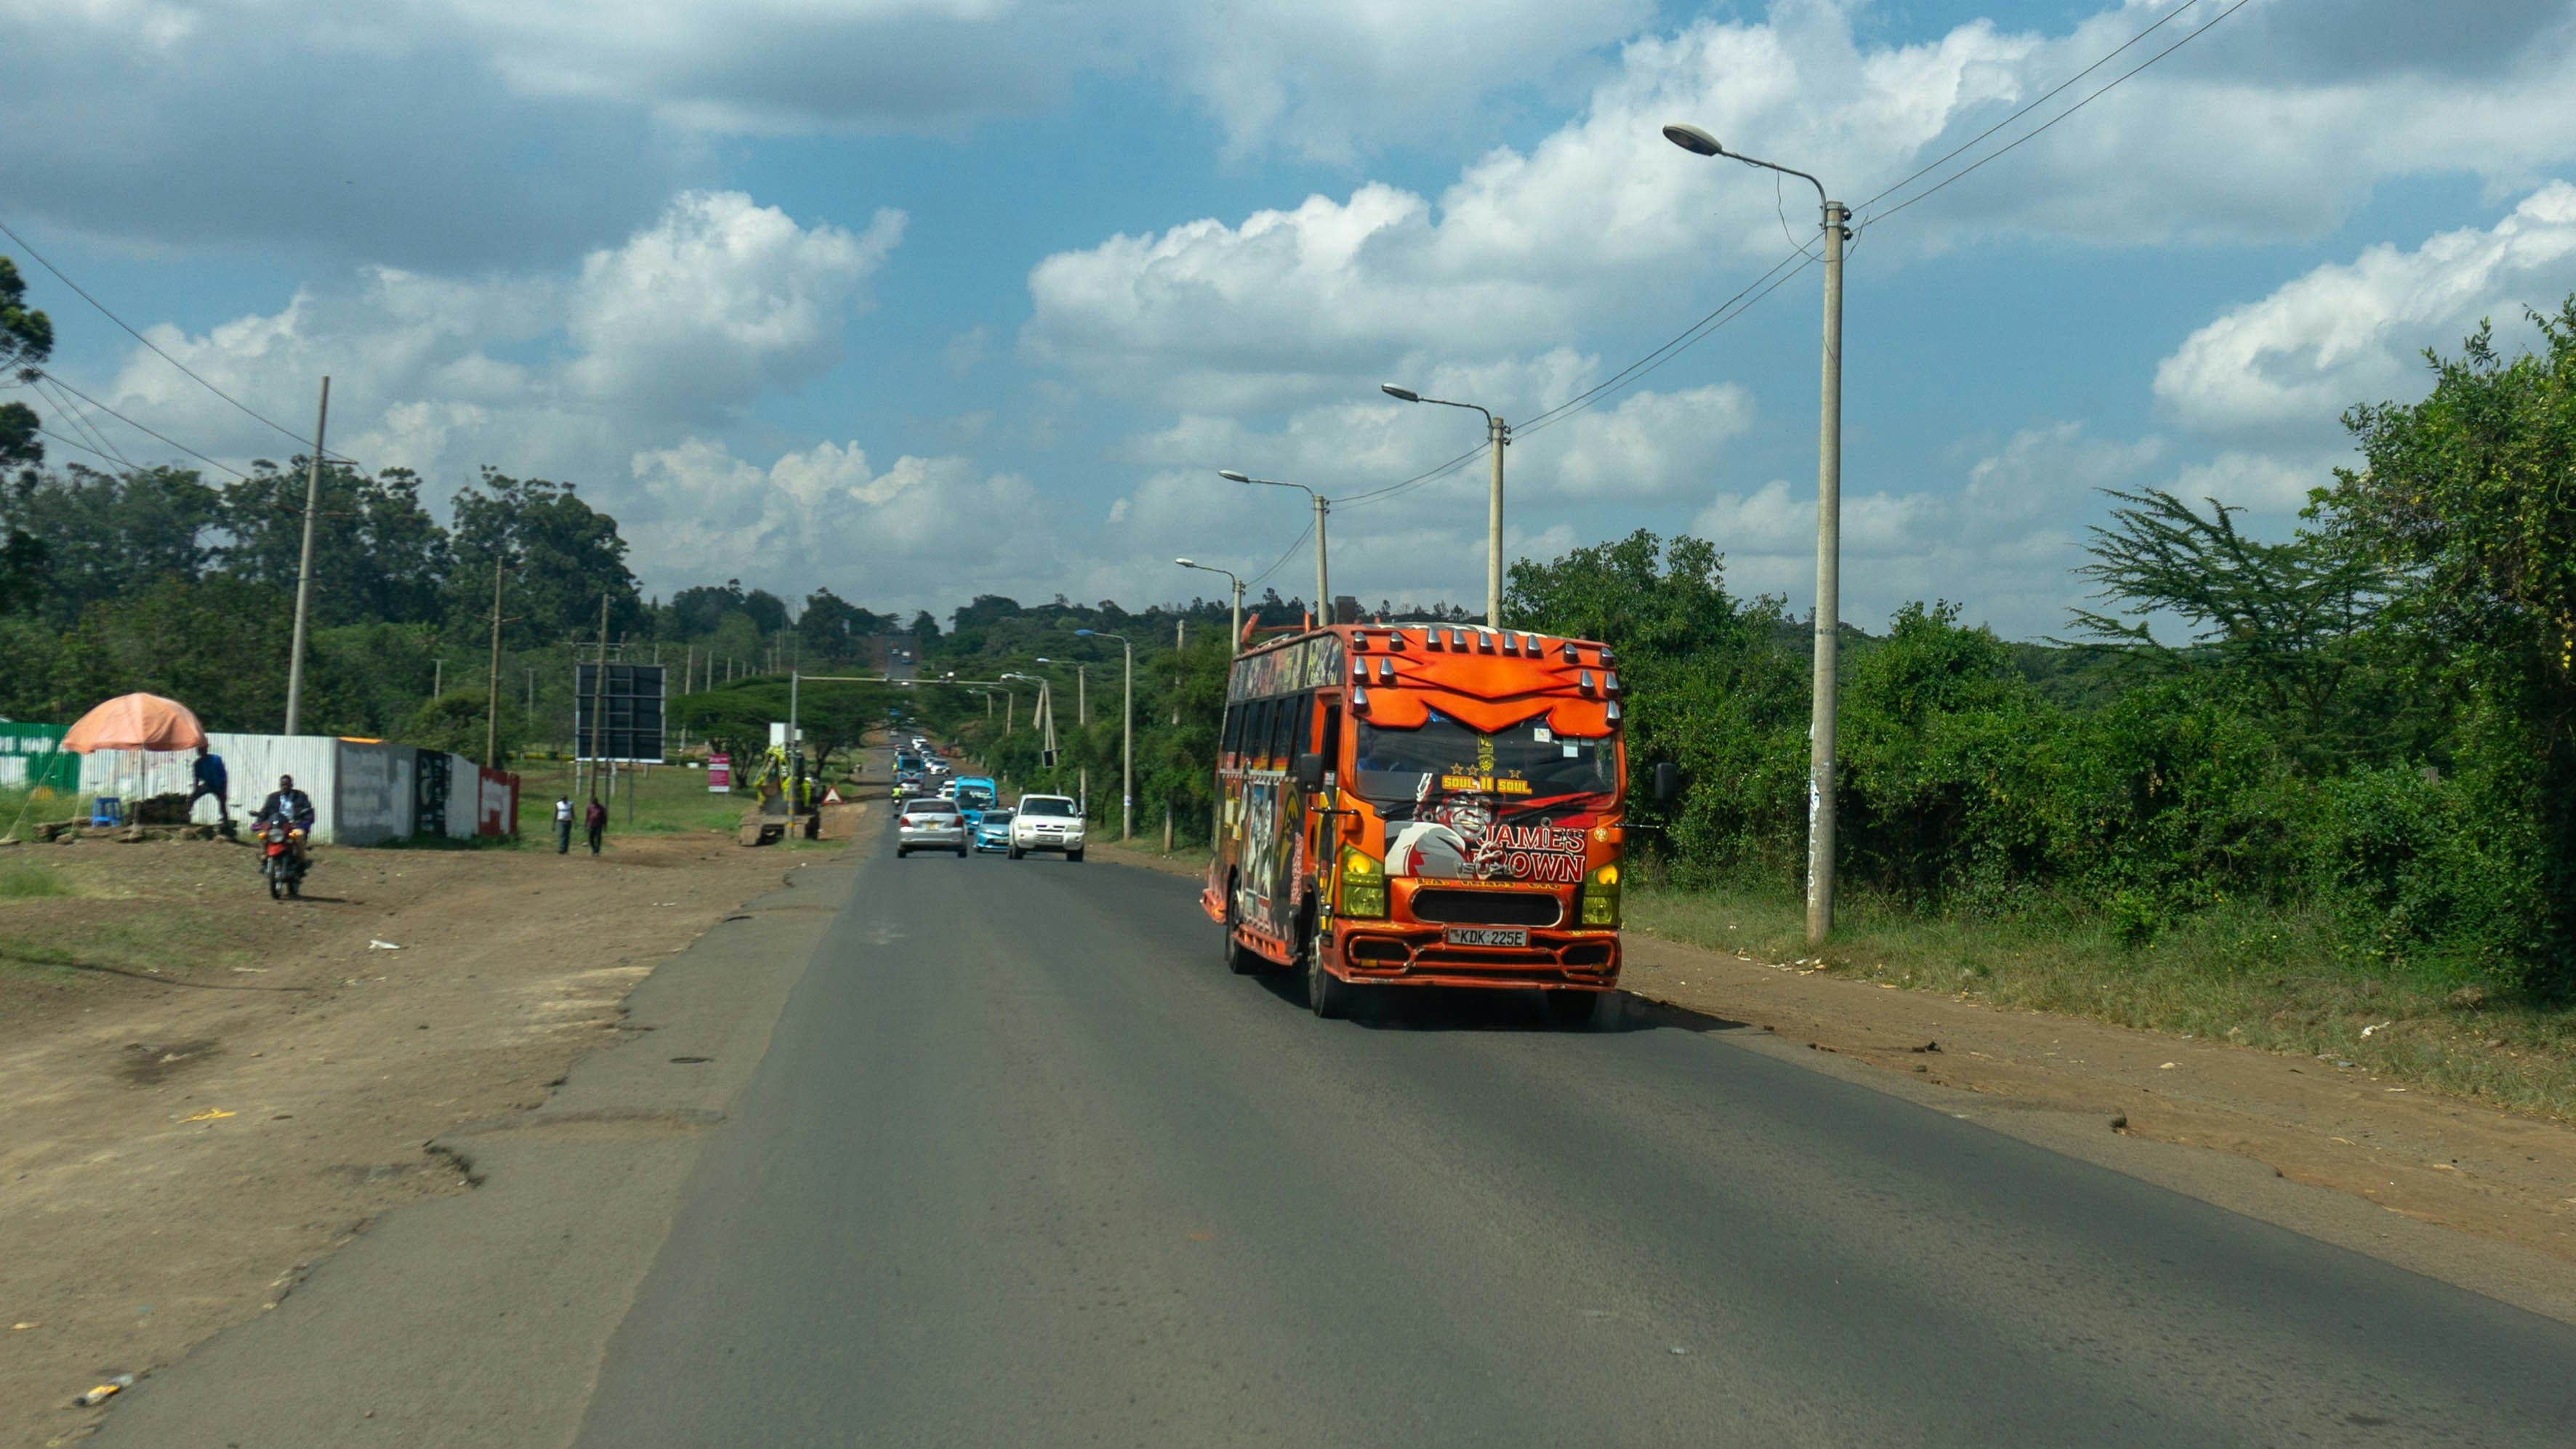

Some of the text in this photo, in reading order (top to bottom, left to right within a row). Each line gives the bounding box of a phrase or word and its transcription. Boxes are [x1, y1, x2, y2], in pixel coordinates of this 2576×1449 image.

[1443, 775, 1477, 790] SOUL
[1497, 779, 1532, 794] SOUL
[1476, 824, 1585, 852] JAMES
[1458, 860, 1517, 876] ISUZU
[1471, 849, 1585, 882] OWN
[1460, 929, 1523, 945] KDK 225E
